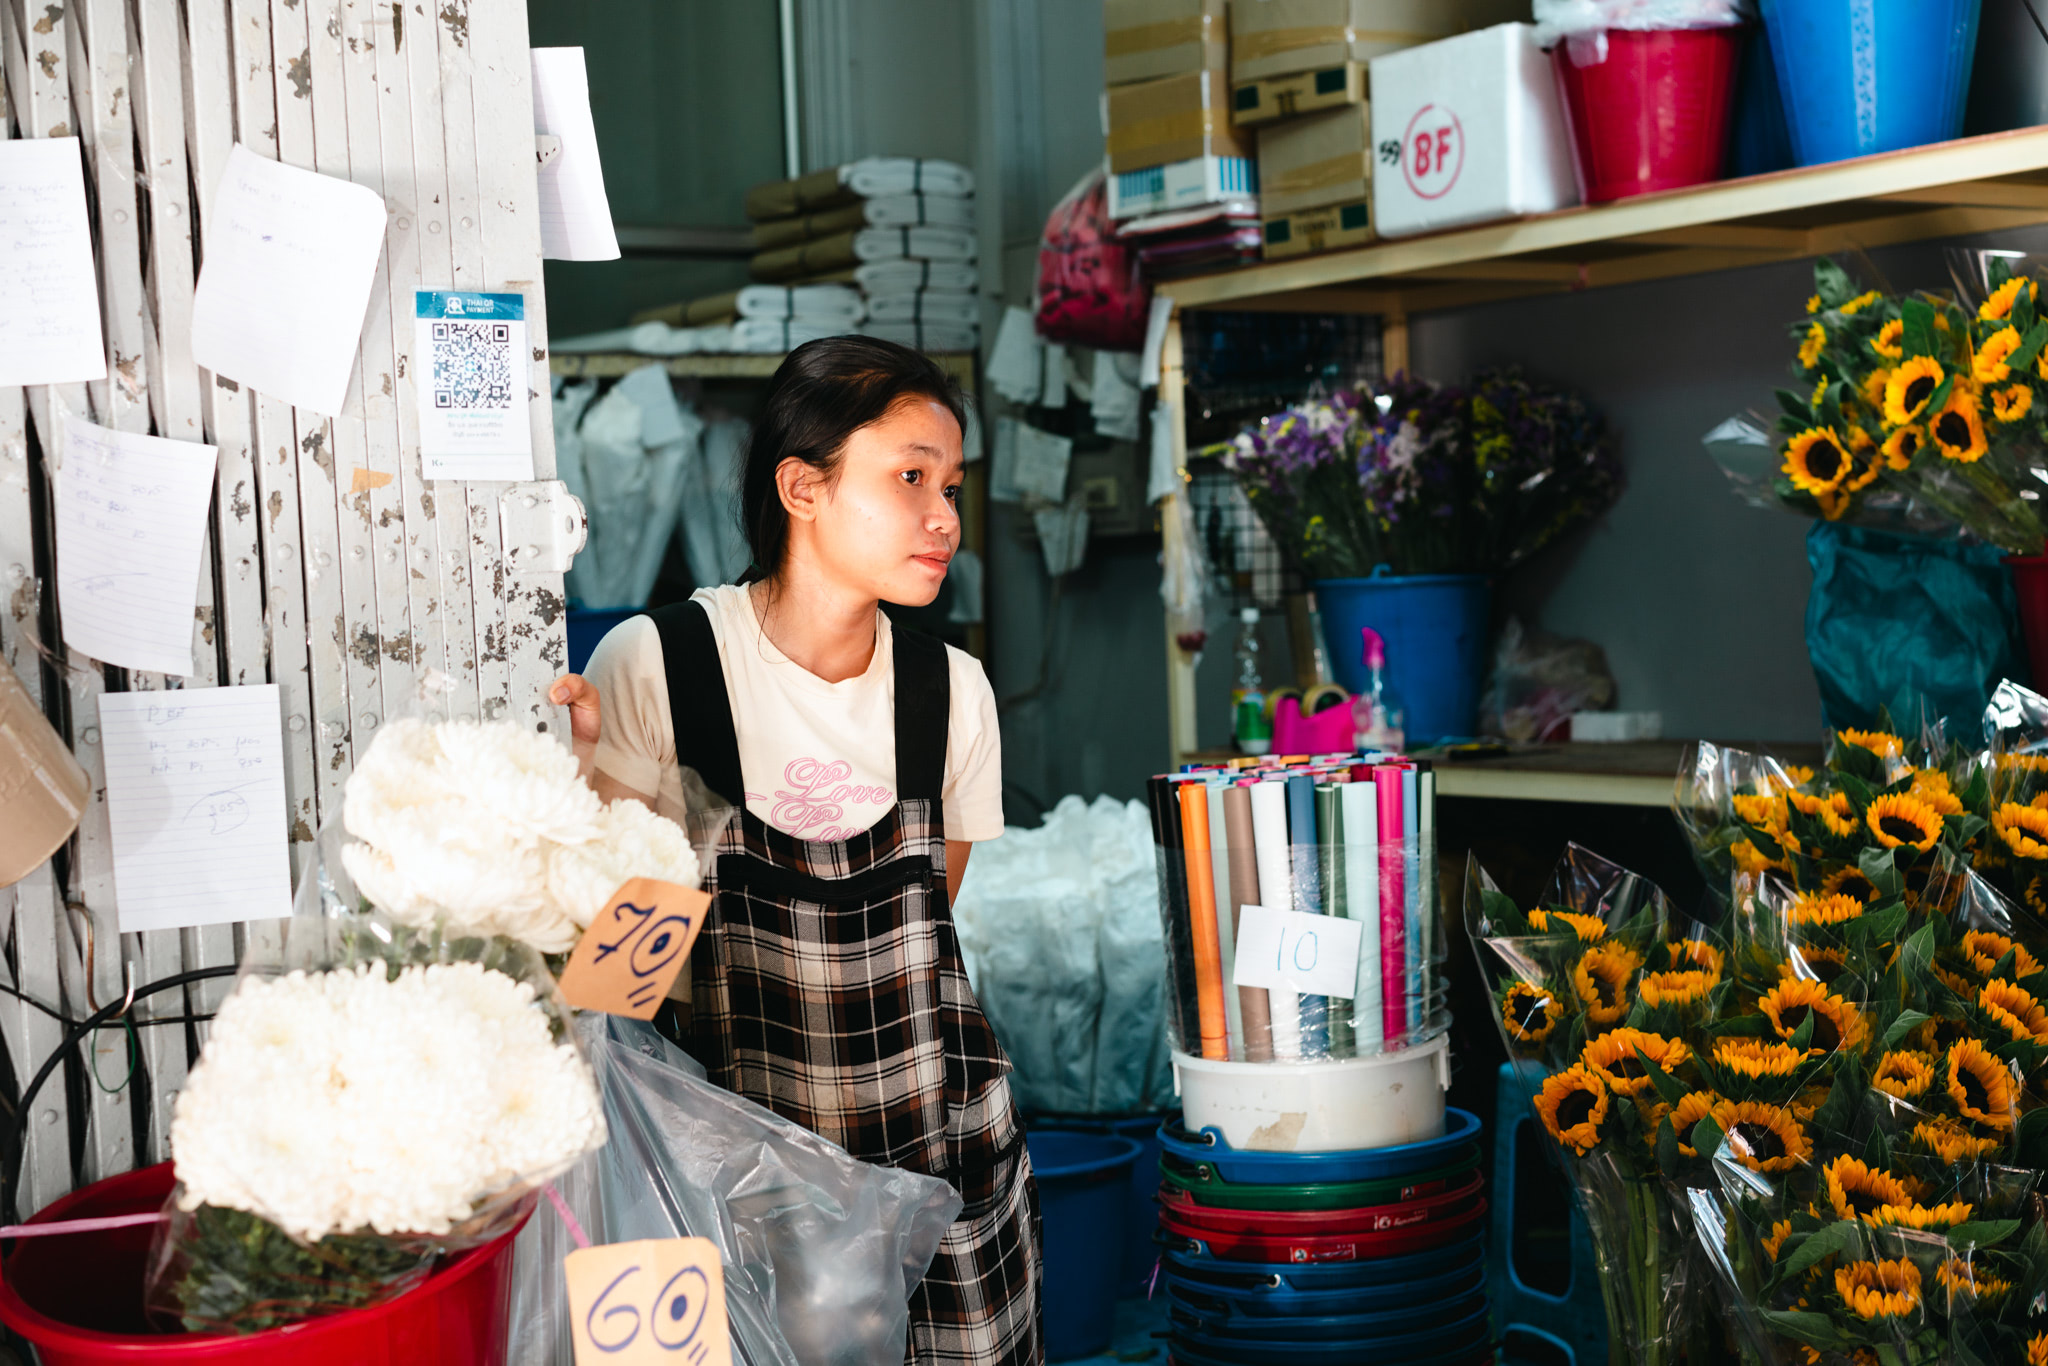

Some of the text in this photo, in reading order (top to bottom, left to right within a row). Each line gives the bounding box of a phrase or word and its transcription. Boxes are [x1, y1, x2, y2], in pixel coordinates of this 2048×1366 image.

[467, 299, 494, 308] THAI QR
[775, 757, 892, 805] Love
[593, 902, 691, 977] 70
[1277, 926, 1318, 971] 10
[586, 1265, 709, 1354] 60
